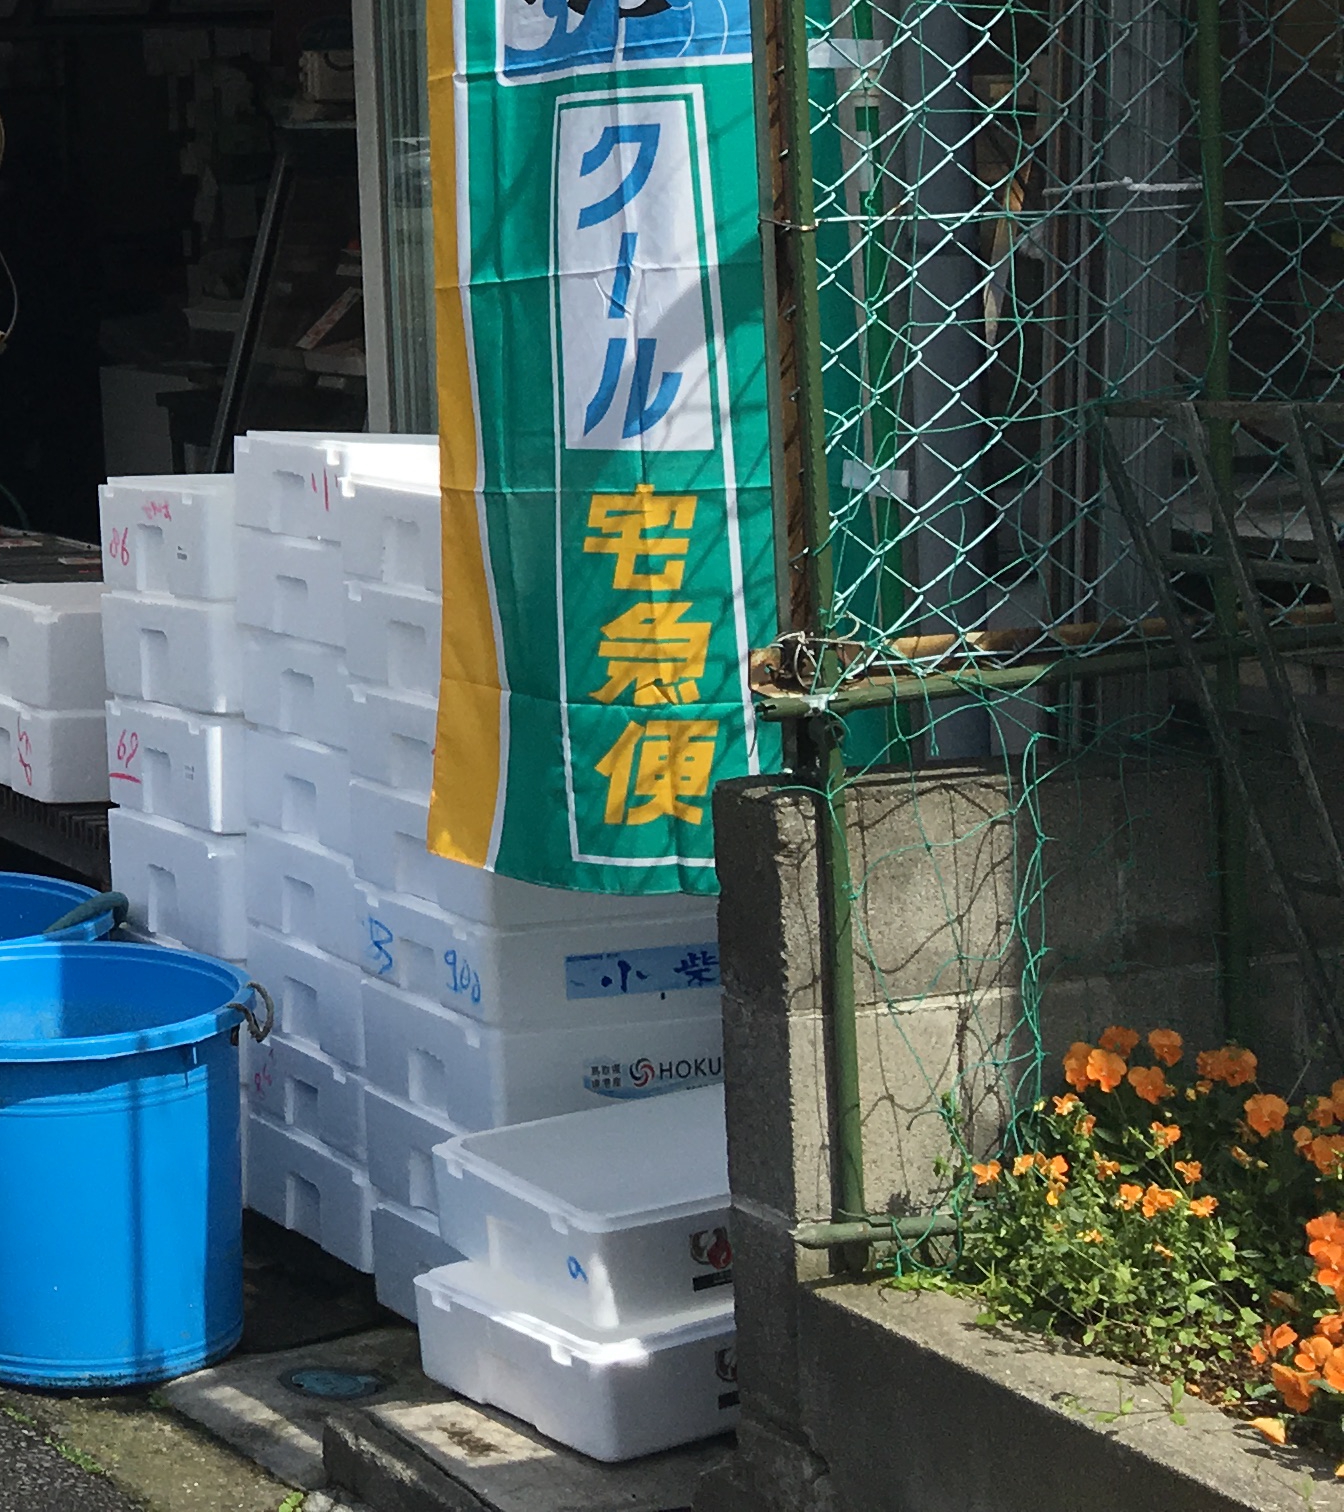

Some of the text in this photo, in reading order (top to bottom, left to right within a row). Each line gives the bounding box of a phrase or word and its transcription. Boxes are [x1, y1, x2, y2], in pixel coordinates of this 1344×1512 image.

[576, 123, 683, 440] クール
[582, 482, 719, 827] 宅急便
